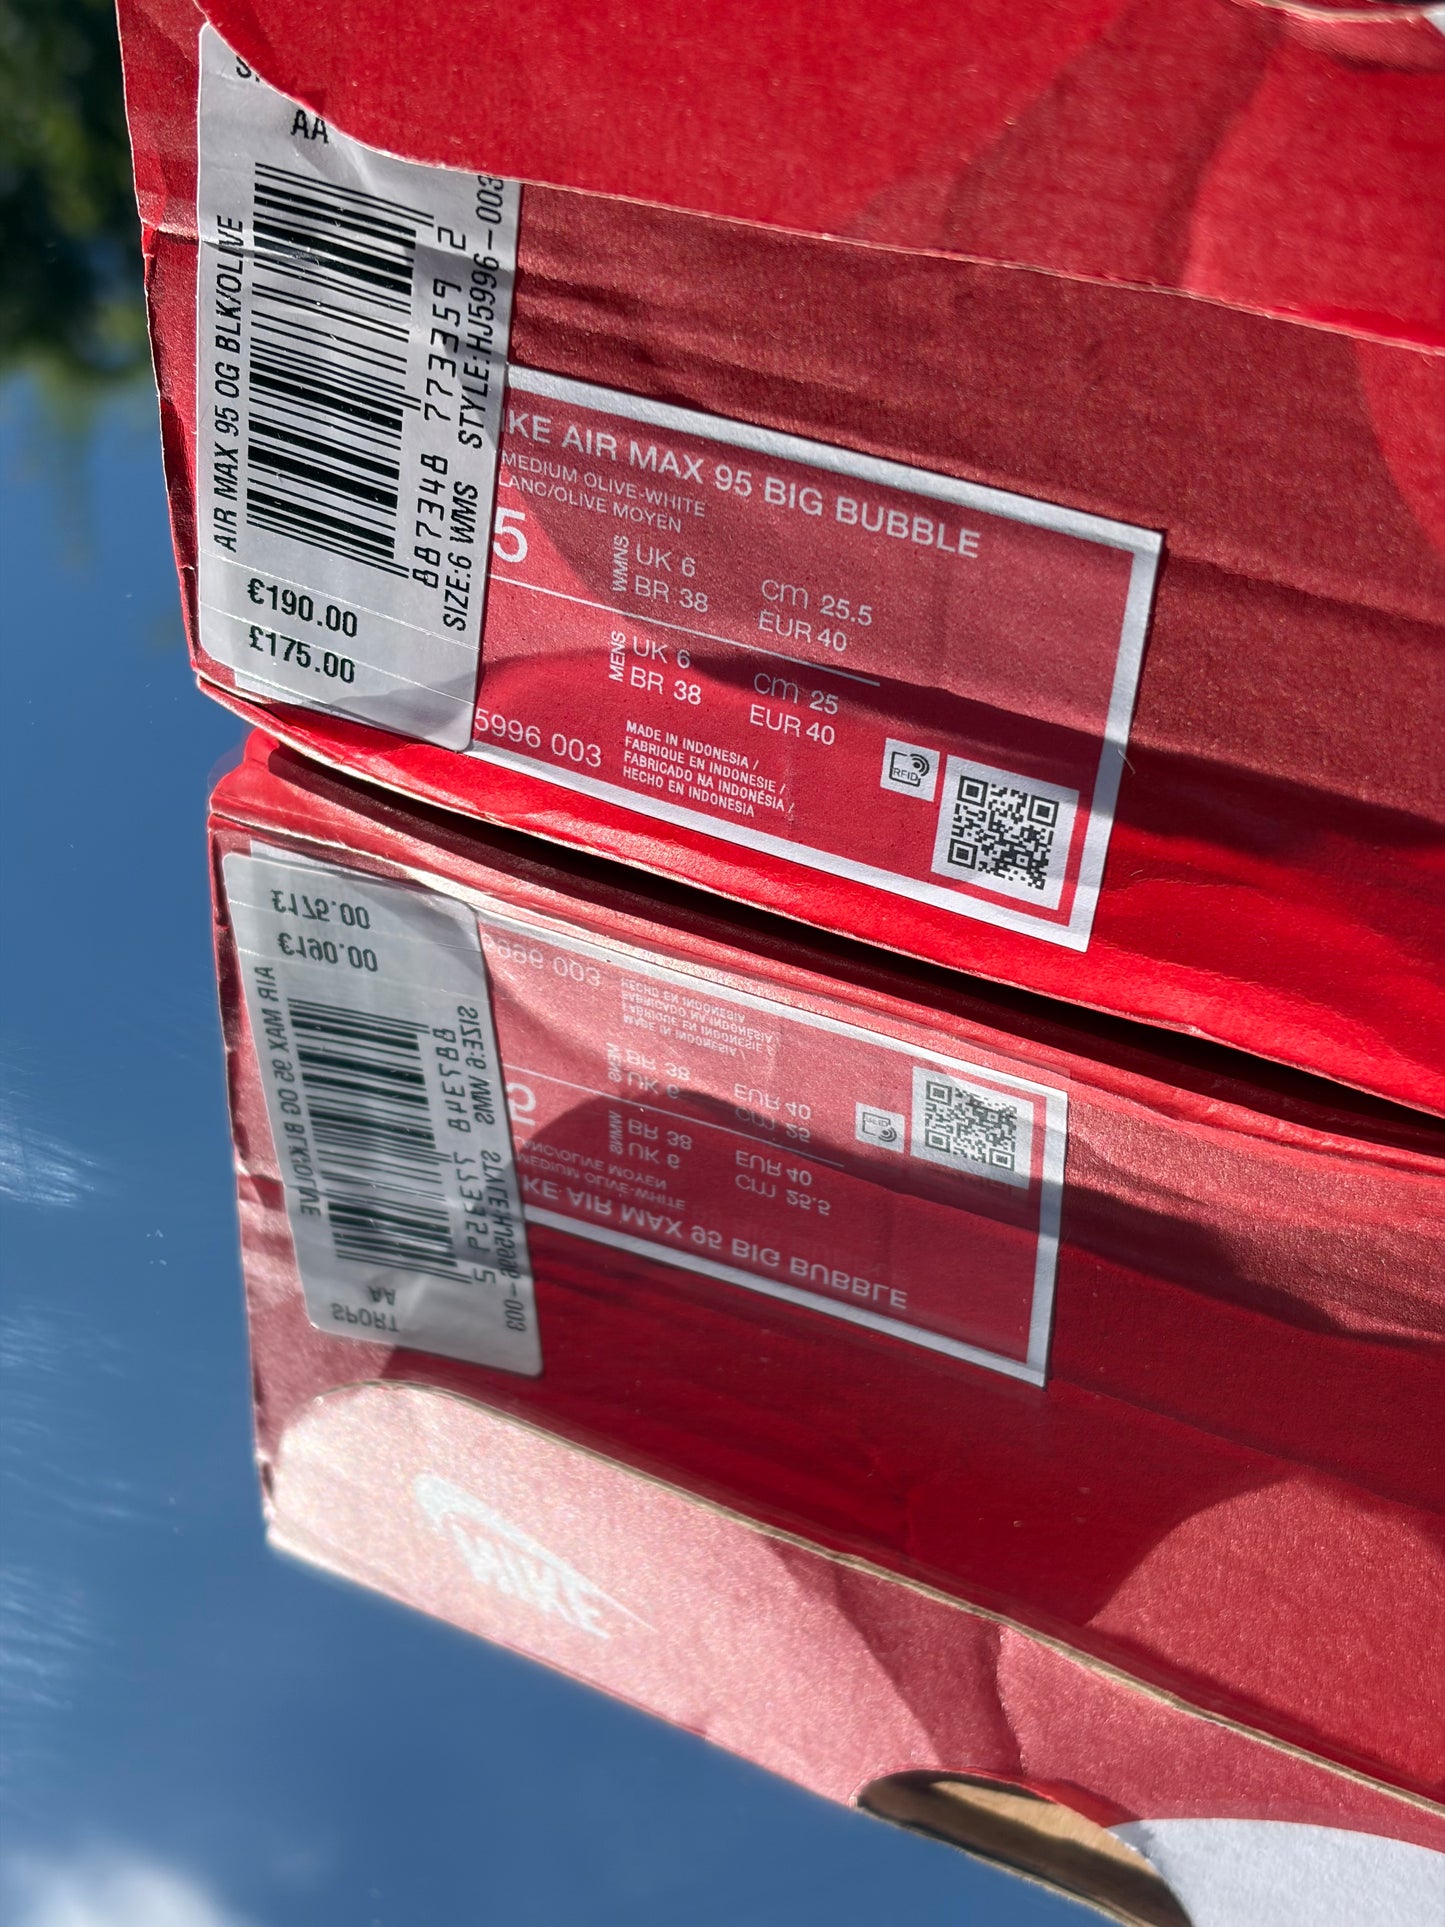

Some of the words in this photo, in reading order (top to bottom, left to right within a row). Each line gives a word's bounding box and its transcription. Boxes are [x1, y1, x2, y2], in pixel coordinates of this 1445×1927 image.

[290, 109, 330, 143] AA
[437, 225, 466, 251] 2
[215, 214, 244, 354] BLK/OLIVE
[424, 278, 462, 421] 773359
[214, 361, 240, 399] OG
[214, 405, 239, 437] 95
[213, 441, 239, 501] MAX
[501, 451, 577, 484] MEDIUM
[583, 471, 706, 518] OLIVE-WHITE
[561, 425, 618, 461] AIR
[629, 440, 705, 485] MAX
[714, 464, 753, 497] 95
[763, 476, 824, 517] BIG
[835, 495, 981, 559] BUBBLE
[213, 507, 237, 553] AIR
[412, 453, 448, 589] 887348
[449, 480, 478, 545] WMS
[613, 503, 682, 534] MOYEN
[612, 534, 630, 593] WMNS
[636, 543, 672, 572] UK
[681, 556, 696, 578] 6
[247, 578, 358, 638] €190.00
[443, 552, 472, 632] SIZE:6
[634, 574, 670, 604] BR
[678, 588, 709, 613] 38
[761, 579, 809, 610] cm
[819, 594, 873, 627] 25.5
[249, 625, 355, 683] £175.00
[632, 636, 668, 665] UK
[676, 649, 691, 670] 6
[758, 609, 812, 643] EUR
[817, 627, 848, 652] 40
[608, 631, 626, 683] MENS
[630, 665, 664, 695] BR
[673, 679, 702, 705] 38
[753, 672, 799, 704] cm
[809, 689, 839, 716] 25
[626, 719, 661, 742] MADE
[665, 732, 679, 747] IN
[682, 736, 749, 770] INDONESIA
[749, 703, 801, 738] EUR
[806, 721, 836, 746] 40
[551, 733, 602, 768] 003
[625, 736, 686, 765] FABRIQUE
[689, 756, 706, 773] EN
[709, 761, 777, 793] INDONESIE
[892, 767, 919, 782] RFID
[623, 766, 665, 789] HECHO
[668, 781, 685, 797] EN
[688, 785, 755, 818] INDONESIA
[624, 750, 693, 782] FABRICADO
[697, 772, 714, 789] NA
[718, 777, 785, 812] INDONÉSIA
